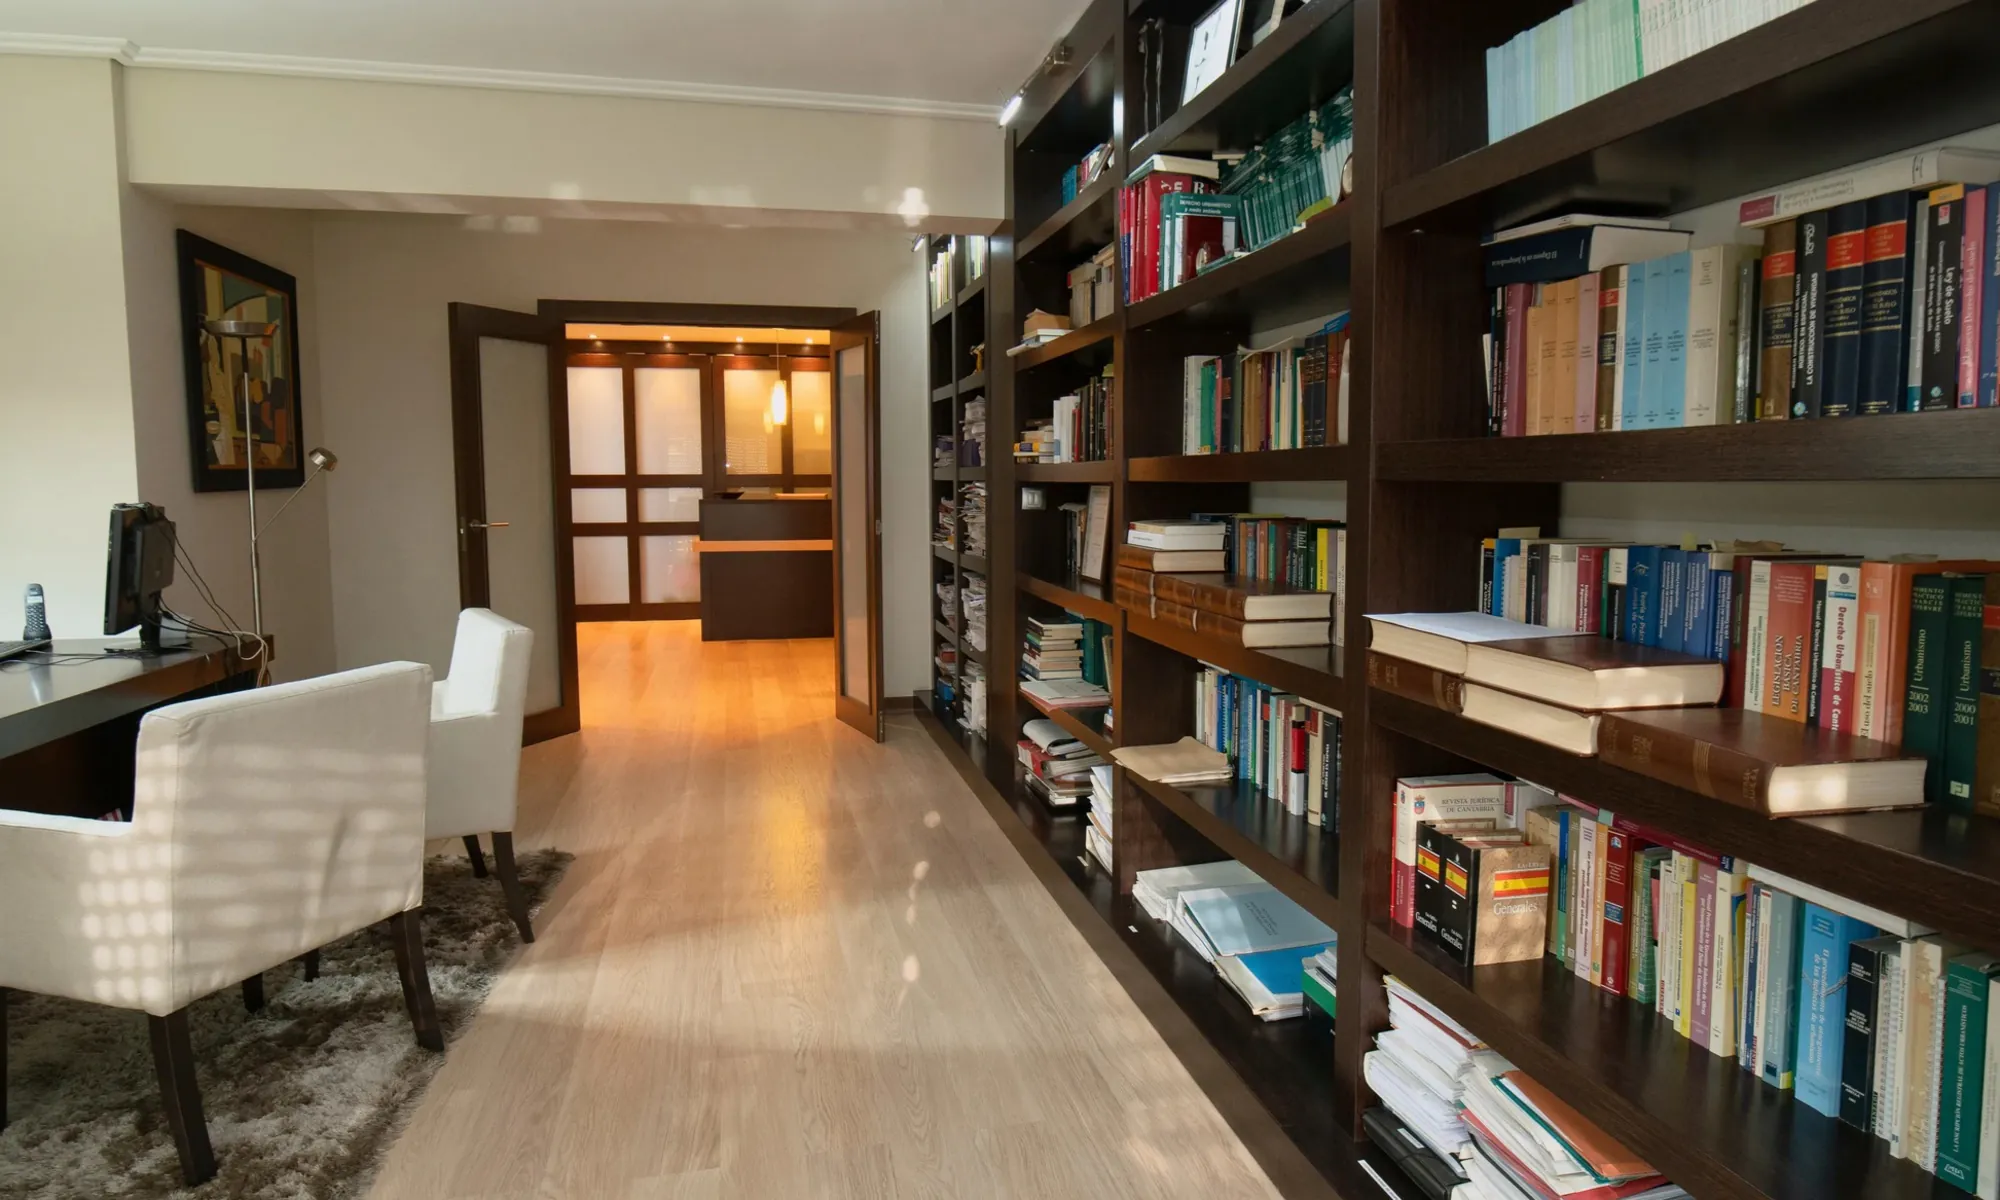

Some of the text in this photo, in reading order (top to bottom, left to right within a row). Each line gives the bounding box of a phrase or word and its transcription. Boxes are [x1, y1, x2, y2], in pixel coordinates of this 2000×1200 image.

[1944, 266, 1955, 324] Ley de Suelo
[1836, 606, 1847, 640] Derecho
[1813, 629, 1821, 652] Derecho
[1913, 629, 1927, 682] Urbanismo
[1833, 644, 1844, 691] Urbanístico
[1960, 640, 1972, 692] Urbanismo
[1791, 635, 1804, 712] DE CANTABRIA
[1864, 670, 1873, 693] suelo
[1832, 694, 1842, 705] de
[1862, 695, 1872, 709] del
[1908, 691, 1929, 703] 2002
[1908, 701, 1929, 714] 2003
[1954, 701, 1977, 714] 2000
[1863, 711, 1871, 726] uso
[1954, 713, 1975, 726] 2001
[1470, 797, 1500, 805] JURÍDICA
[1457, 805, 1495, 813] CANTABRIA
[1494, 901, 1538, 916] Generales
[1416, 911, 1438, 933] Generales
[1441, 927, 1463, 950] Generales
[1814, 953, 1820, 962] de
[1822, 948, 1829, 957] El
[1818, 958, 1828, 1013] procedimiento
[1810, 1012, 1817, 1022] de
[1818, 1015, 1825, 1024] de
[1957, 1066, 1964, 1074] DE
